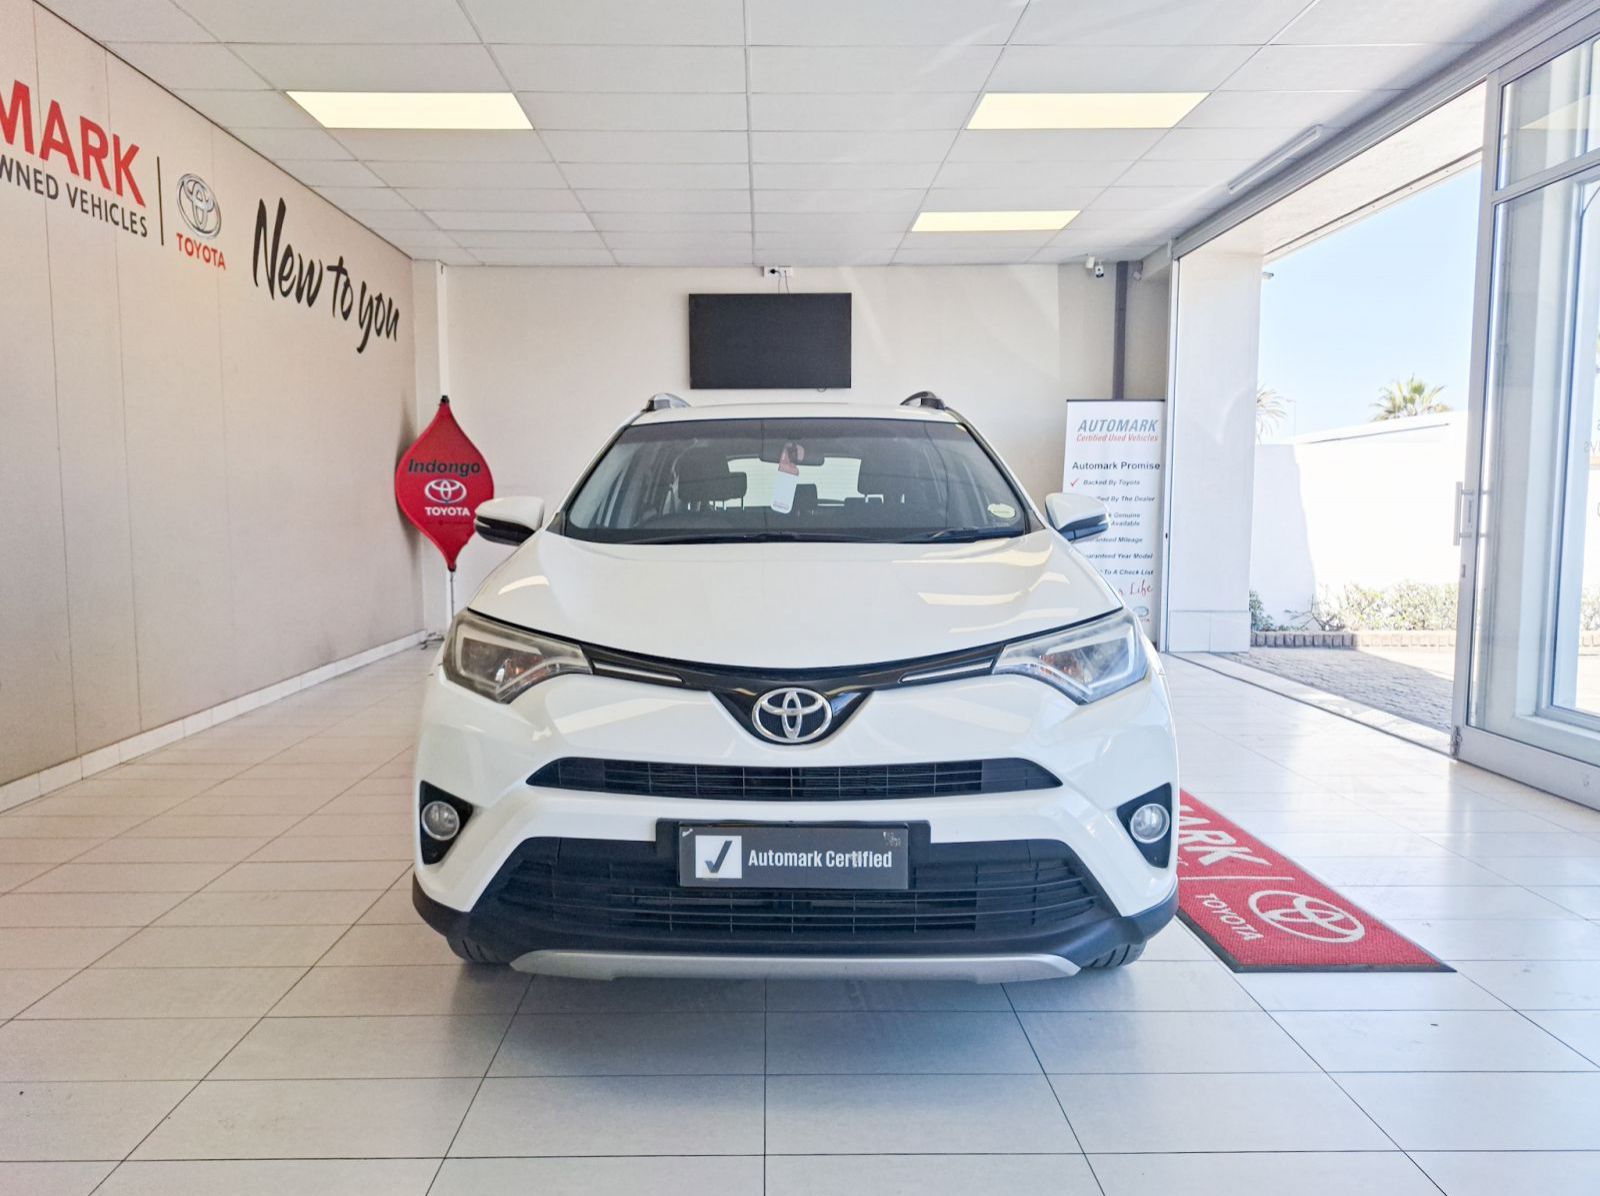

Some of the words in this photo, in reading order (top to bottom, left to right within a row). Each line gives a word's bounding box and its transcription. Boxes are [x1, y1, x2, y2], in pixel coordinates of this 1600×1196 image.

[0, 79, 146, 207] MARK
[66, 182, 148, 238] VEHICLES
[176, 232, 226, 270] TOYOTA
[253, 197, 323, 307] New
[327, 256, 353, 321] to
[356, 281, 399, 354] you
[1077, 419, 1158, 432] AUTOMARK
[1077, 433, 1107, 442] Certified
[1107, 433, 1126, 442] Used
[1127, 433, 1158, 442] Vehicles
[408, 459, 480, 477] Indongo
[1072, 461, 1118, 470] Automark
[1120, 461, 1160, 470] Promise
[1108, 479, 1117, 487] By
[1119, 479, 1141, 487] Toyota
[425, 506, 470, 516] TOYOTA
[1118, 536, 1143, 544] Mileage
[748, 849, 823, 868] Automark
[826, 849, 893, 869] Certified
[1194, 892, 1264, 942] TOYOTA
